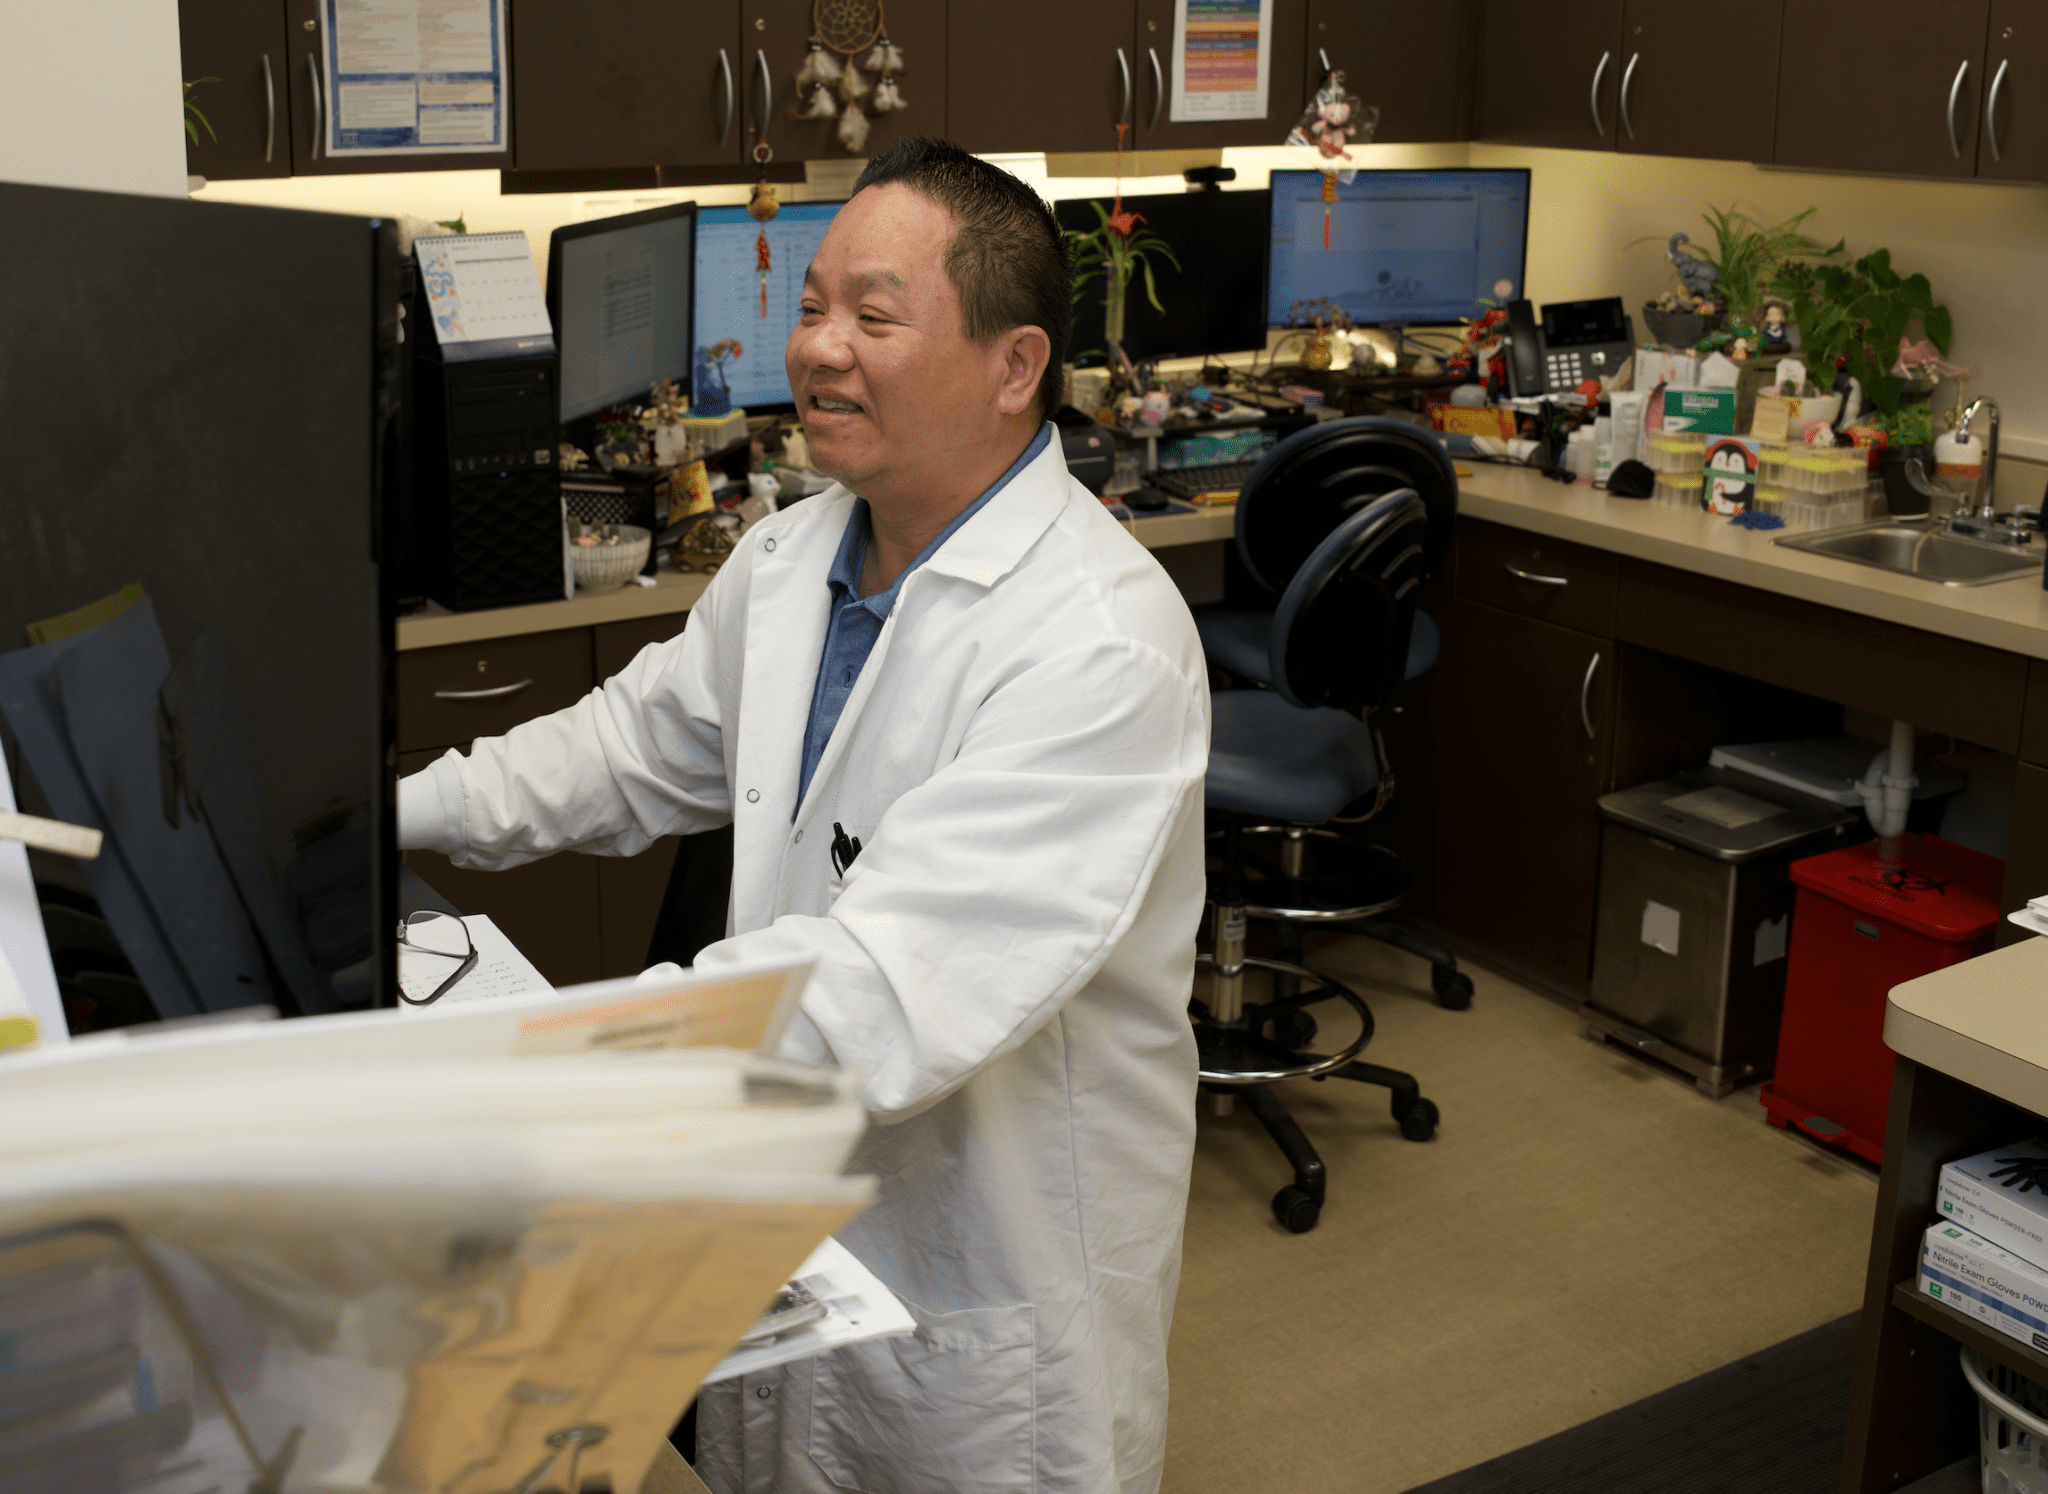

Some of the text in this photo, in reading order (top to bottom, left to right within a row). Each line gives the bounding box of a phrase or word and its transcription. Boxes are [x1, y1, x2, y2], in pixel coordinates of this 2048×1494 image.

[1945, 1188, 1961, 1201] Nitrile
[1962, 1196, 1978, 1209] Exam
[1978, 1205, 1999, 1221] Gloves
[2000, 1216, 2043, 1244] POWDER-FREE
[1933, 1251, 1959, 1270] Nitrile
[1960, 1264, 1985, 1282] Exam
[1987, 1277, 2020, 1299] Gloves
[1949, 1291, 1962, 1302] 100
